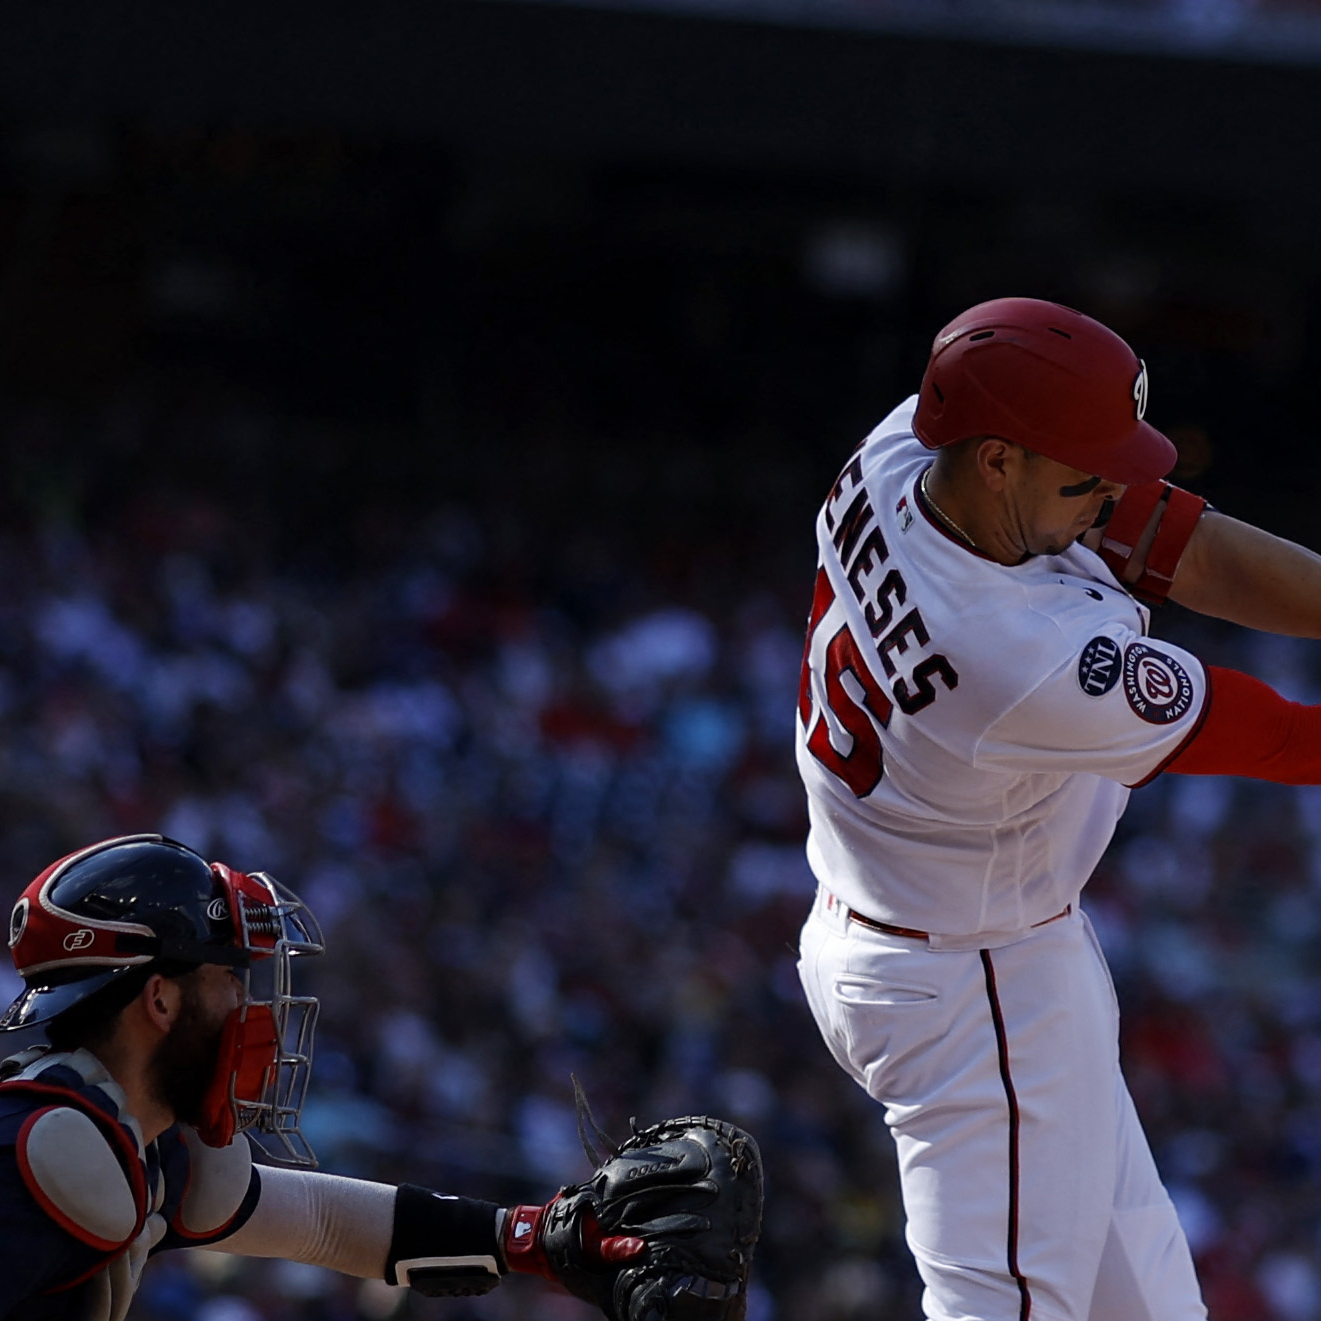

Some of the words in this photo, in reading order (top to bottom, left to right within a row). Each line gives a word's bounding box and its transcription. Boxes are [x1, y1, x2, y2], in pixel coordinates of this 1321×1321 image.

[1084, 641, 1117, 692] TNL
[1126, 646, 1149, 713] WASHINGTON
[1165, 658, 1191, 719] NATIONALS
